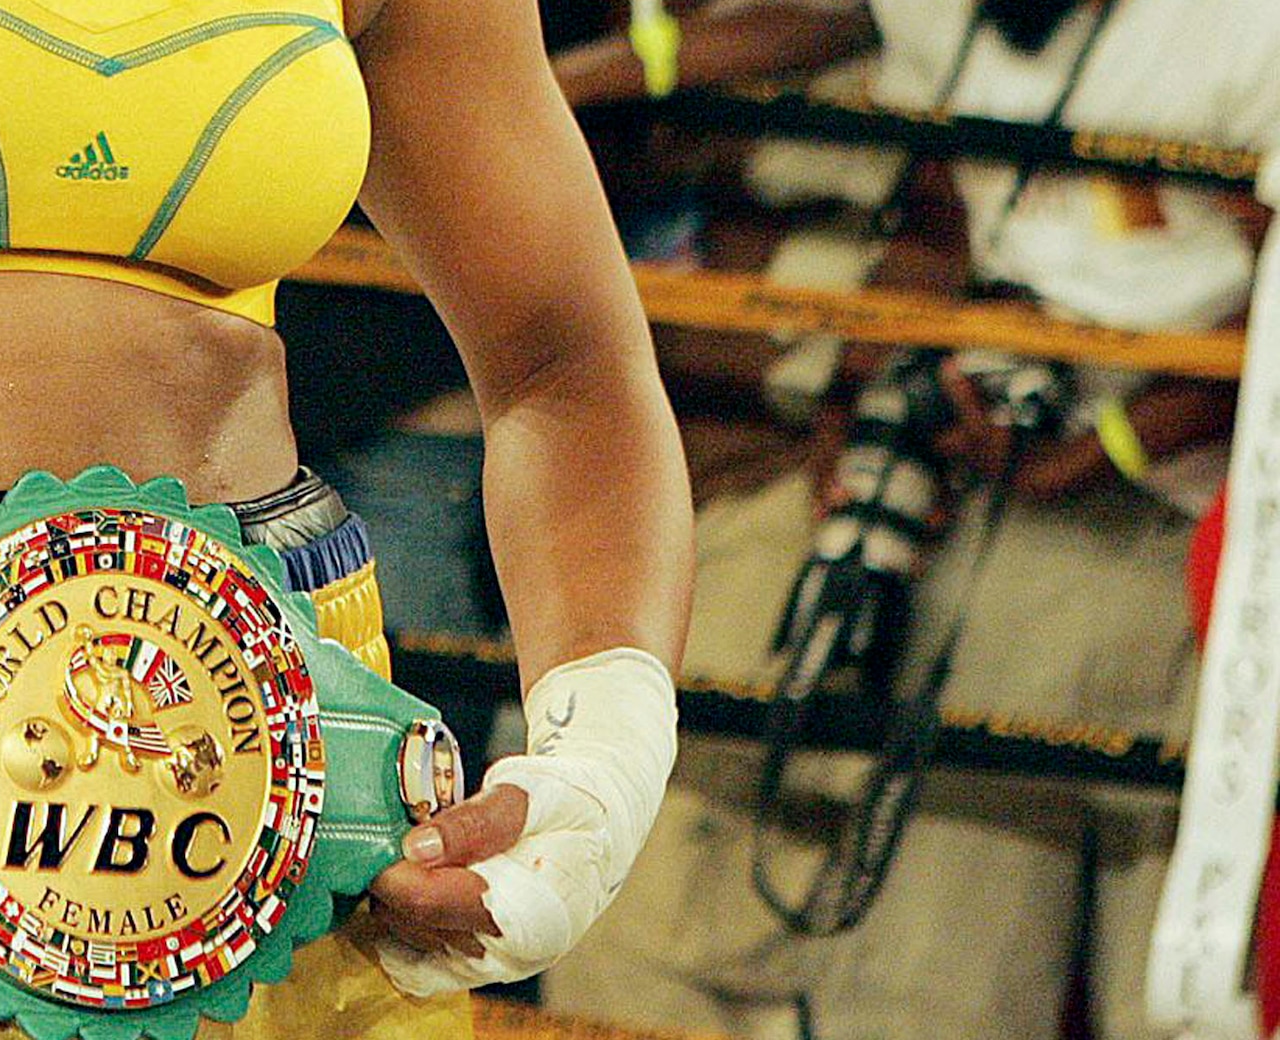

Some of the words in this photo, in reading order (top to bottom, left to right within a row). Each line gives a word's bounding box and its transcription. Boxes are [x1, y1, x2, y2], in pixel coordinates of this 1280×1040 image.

[93, 586, 262, 756] CHAMPION
[3, 801, 232, 879] WBC
[37, 887, 188, 936] FEMALE
